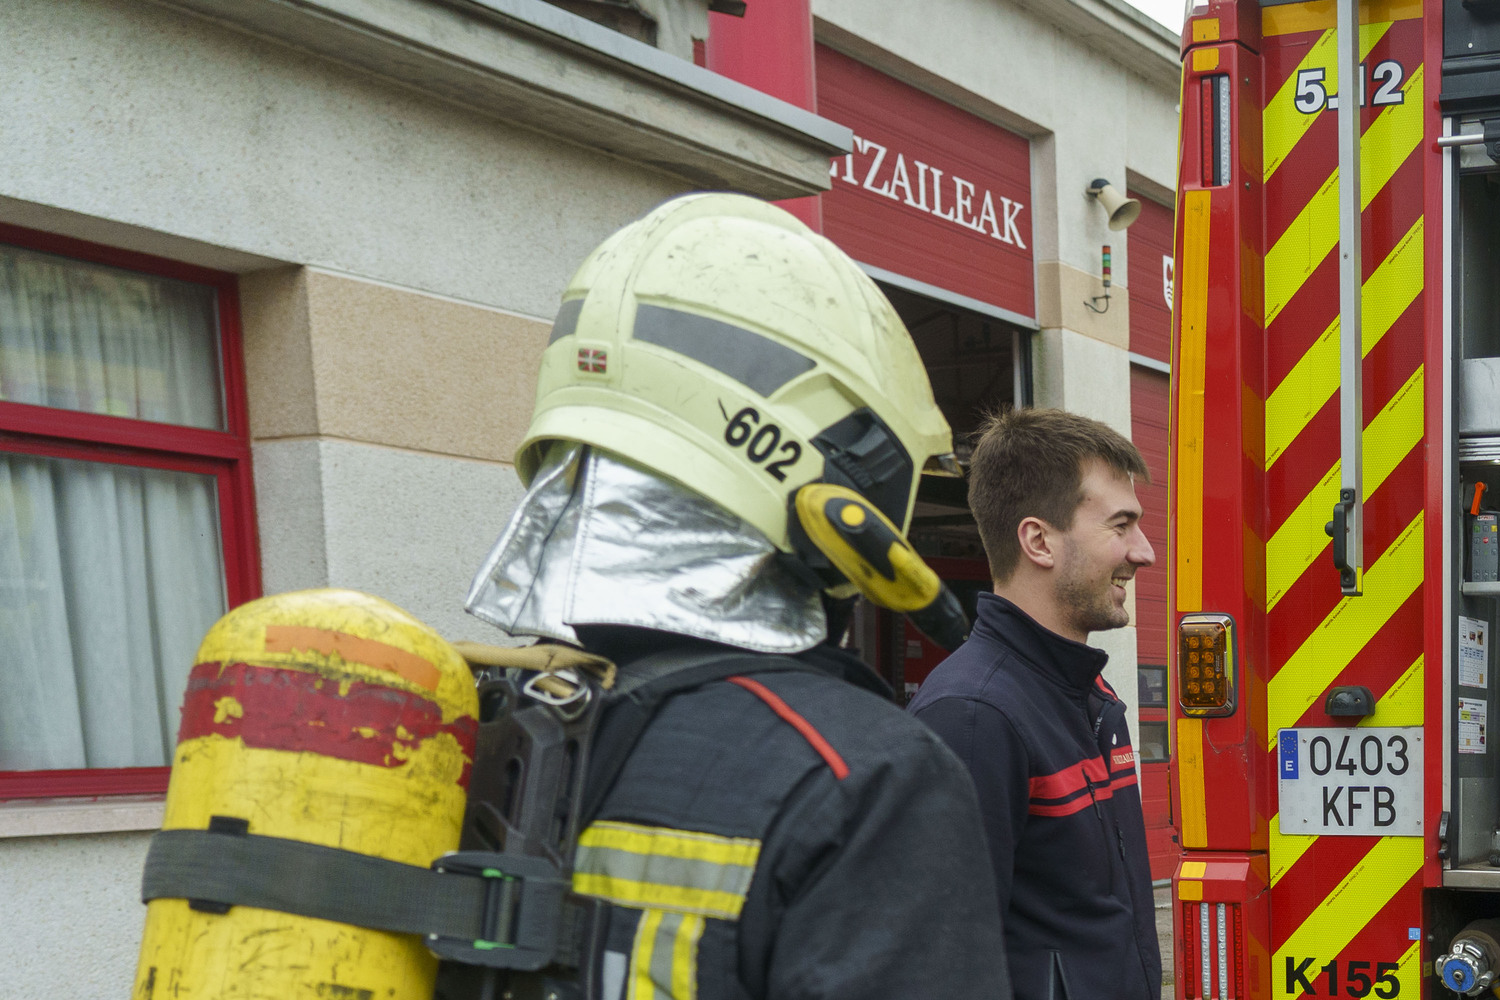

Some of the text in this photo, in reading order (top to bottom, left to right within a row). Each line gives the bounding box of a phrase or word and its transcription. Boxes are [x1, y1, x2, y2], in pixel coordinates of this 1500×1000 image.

[829, 134, 1026, 250] TZAILEAK
[724, 406, 802, 483] 602
[1285, 760, 1294, 771] E
[1309, 735, 1409, 776] 0403
[1323, 786, 1397, 827] KFB
[1285, 956, 1400, 1000] K155
